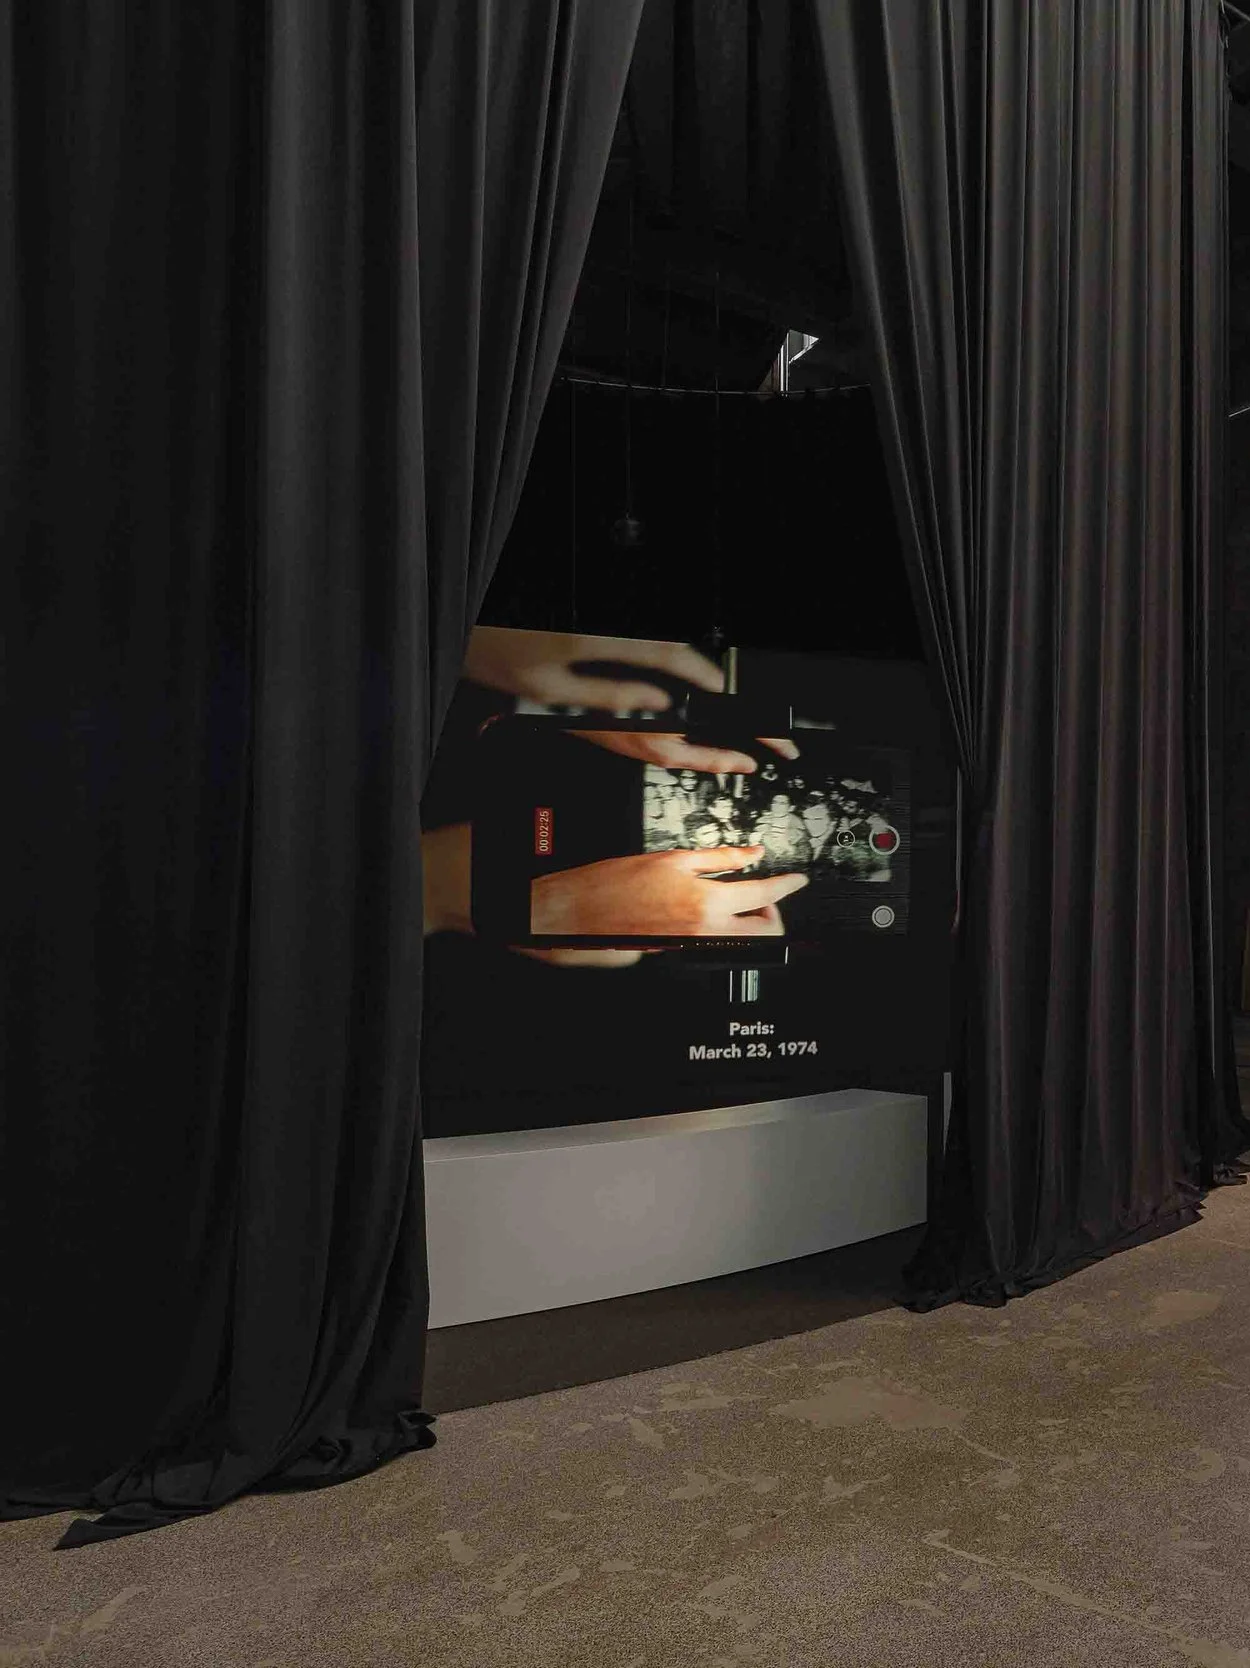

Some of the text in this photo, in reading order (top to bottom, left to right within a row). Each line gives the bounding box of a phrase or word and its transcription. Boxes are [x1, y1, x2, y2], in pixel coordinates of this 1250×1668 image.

[539, 810, 550, 852] 00:02:25
[729, 1021, 775, 1036] Paris:
[689, 1041, 818, 1060] March 23, 1974
